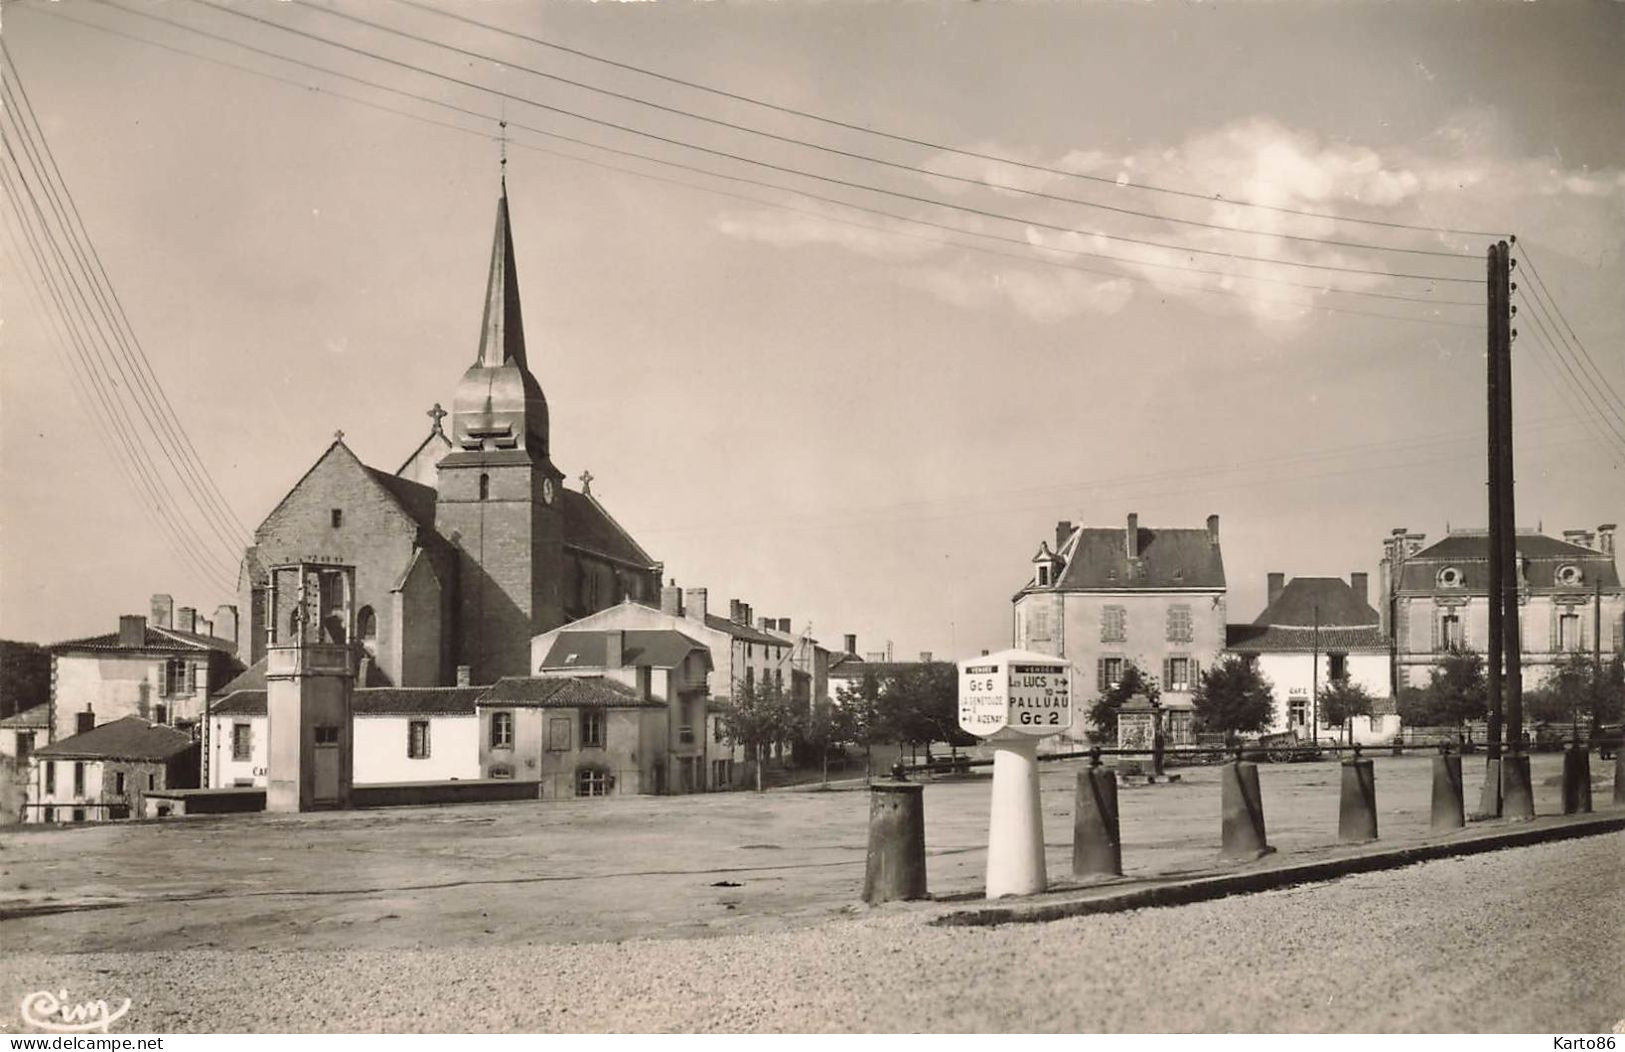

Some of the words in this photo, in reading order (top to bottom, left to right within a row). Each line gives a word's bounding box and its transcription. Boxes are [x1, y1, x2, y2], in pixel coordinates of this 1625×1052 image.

[970, 679, 983, 691] Gc
[986, 679, 994, 691] 6
[1023, 675, 1047, 688] LUCS
[1009, 696, 1069, 708] PALLUAU
[1020, 711, 1042, 725] Gc
[1049, 711, 1059, 725] 2
